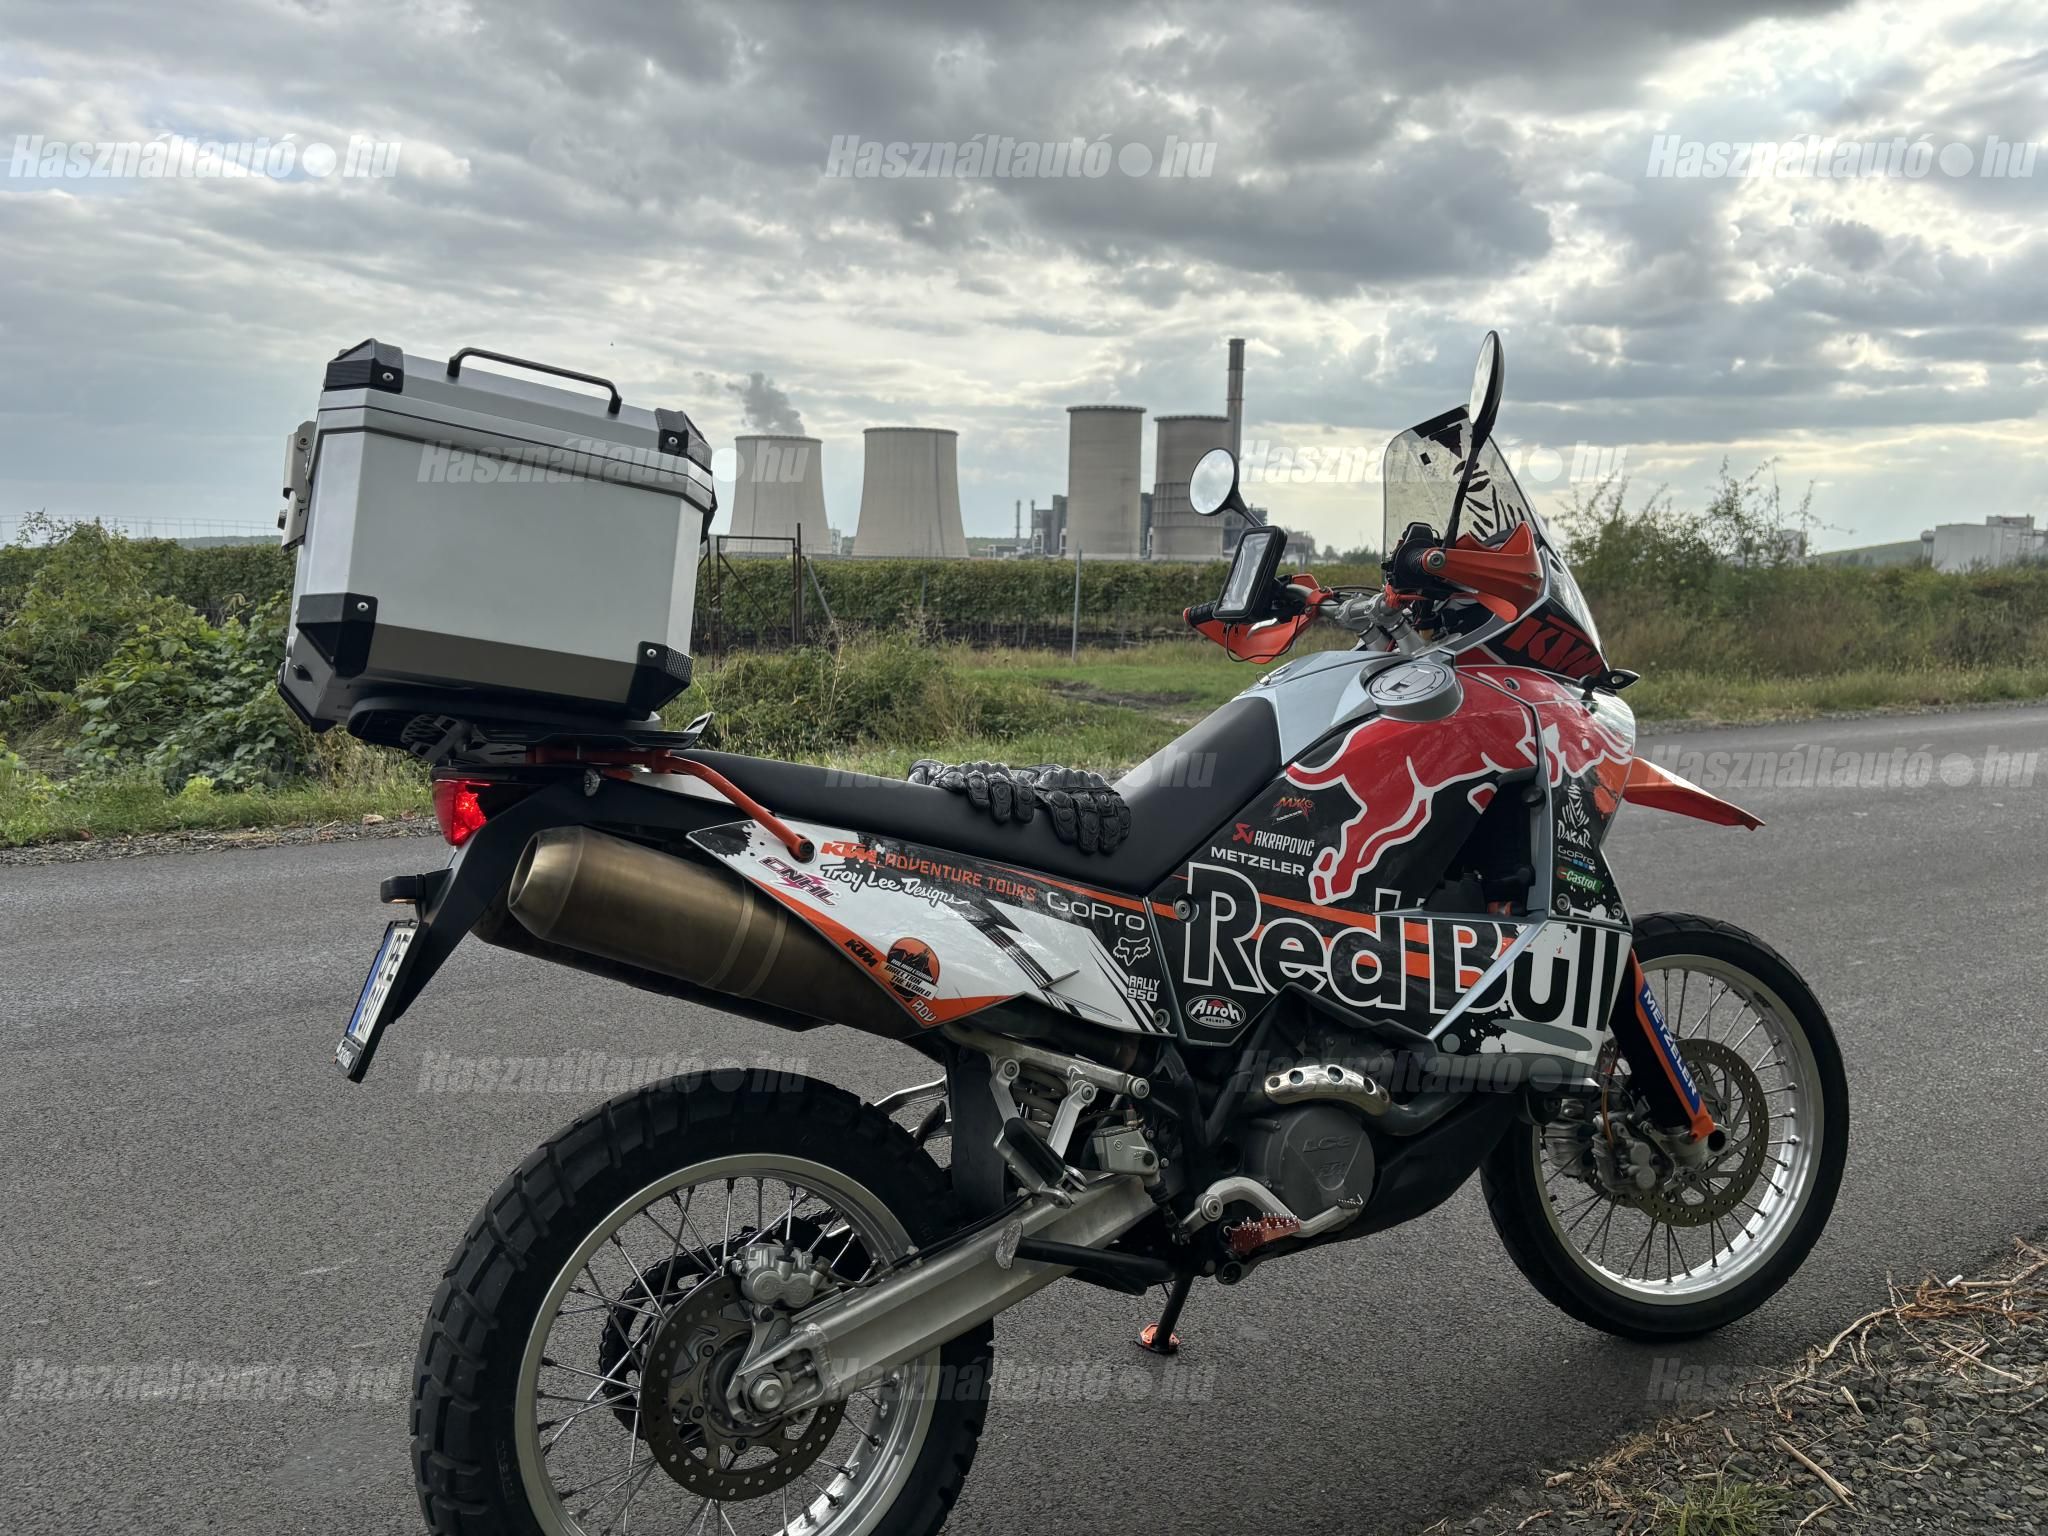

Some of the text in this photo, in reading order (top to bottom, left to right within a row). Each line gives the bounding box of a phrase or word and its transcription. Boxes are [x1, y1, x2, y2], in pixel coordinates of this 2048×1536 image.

[1557, 819, 1593, 849] DAKAR
[821, 841, 1038, 901] KTM ADVENTURE TOURS
[1210, 846, 1306, 877] METZELER
[1557, 846, 1595, 866] GoPro
[821, 864, 971, 908] Troy Lee Designs
[1566, 870, 1597, 891] Castrol
[1046, 890, 1146, 931] GoPro
[844, 938, 878, 968] KTM
[1183, 862, 1621, 1032] Red Bull
[1127, 987, 1159, 1002] 950
[1128, 975, 1160, 992] RALLY
[911, 999, 937, 1022] ADV
[1190, 999, 1241, 1021] Airoh
[1643, 988, 1698, 1097] METZELER
